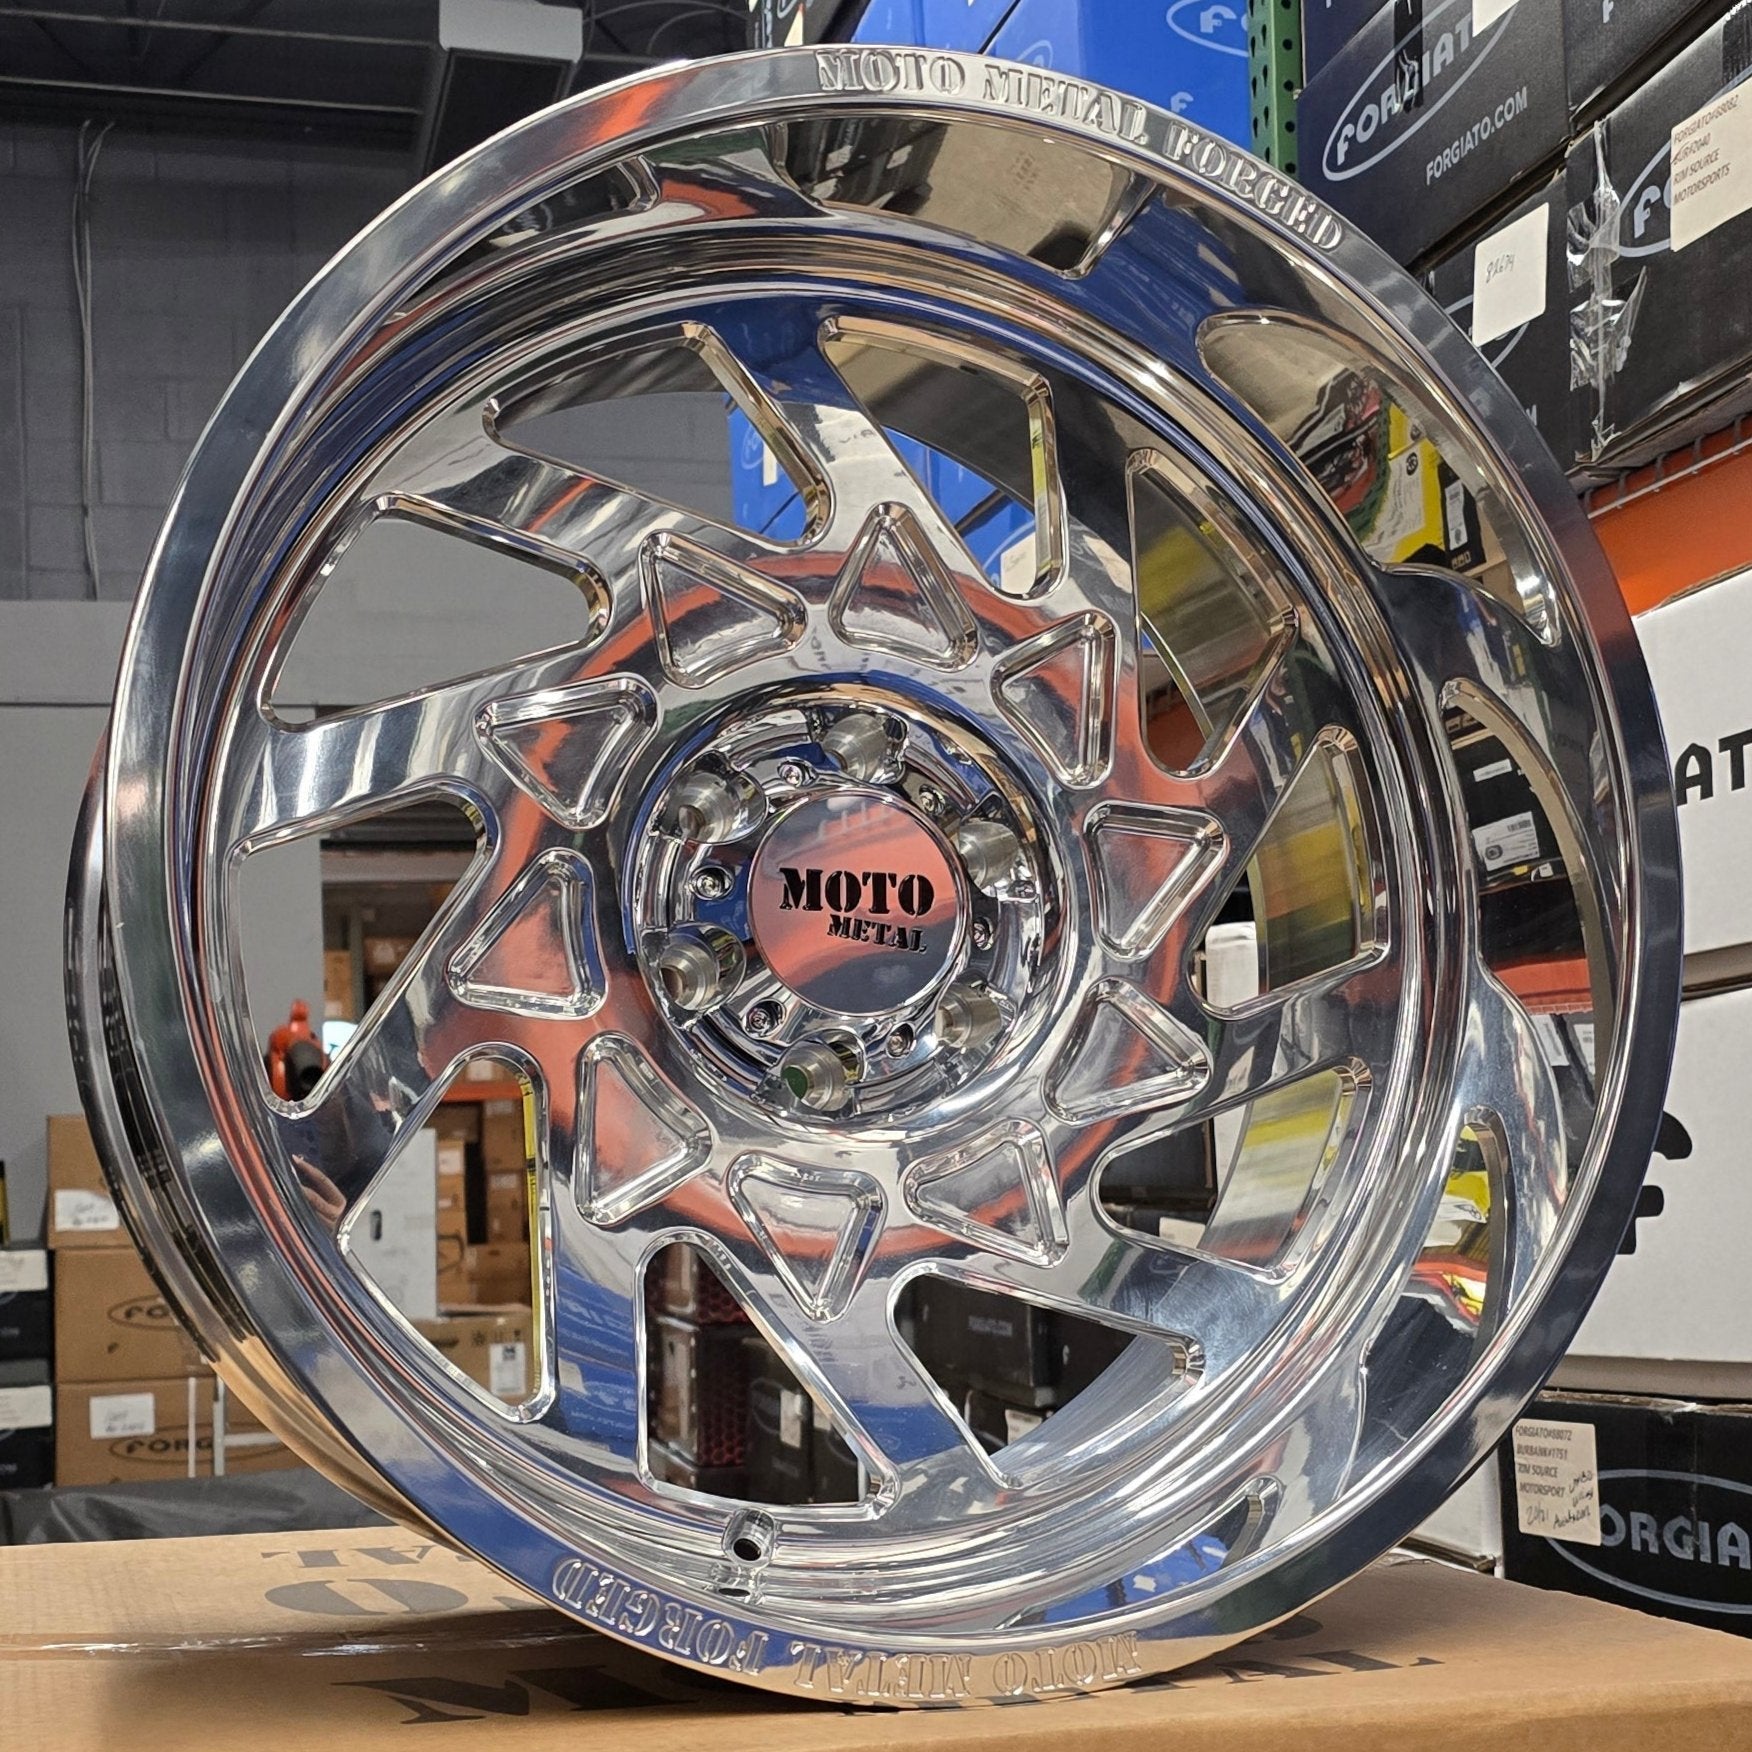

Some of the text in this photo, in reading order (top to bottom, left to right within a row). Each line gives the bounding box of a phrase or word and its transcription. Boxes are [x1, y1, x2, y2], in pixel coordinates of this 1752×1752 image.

[815, 49, 1342, 250] MOTO METAL FORGED
[1426, 86, 1528, 186] FORGIATO.COM
[1673, 162, 1732, 206] MOTORSPORTS
[1689, 148, 1720, 177] SOURCE
[779, 867, 935, 917] MOTO
[826, 914, 927, 954] METAL
[1519, 1482, 1566, 1498] MOTORSPORT
[1532, 1464, 1559, 1478] SOURCE
[552, 1558, 769, 1676] FORGED
[790, 1640, 971, 1699] METAL
[993, 1630, 1142, 1696] MOTO
